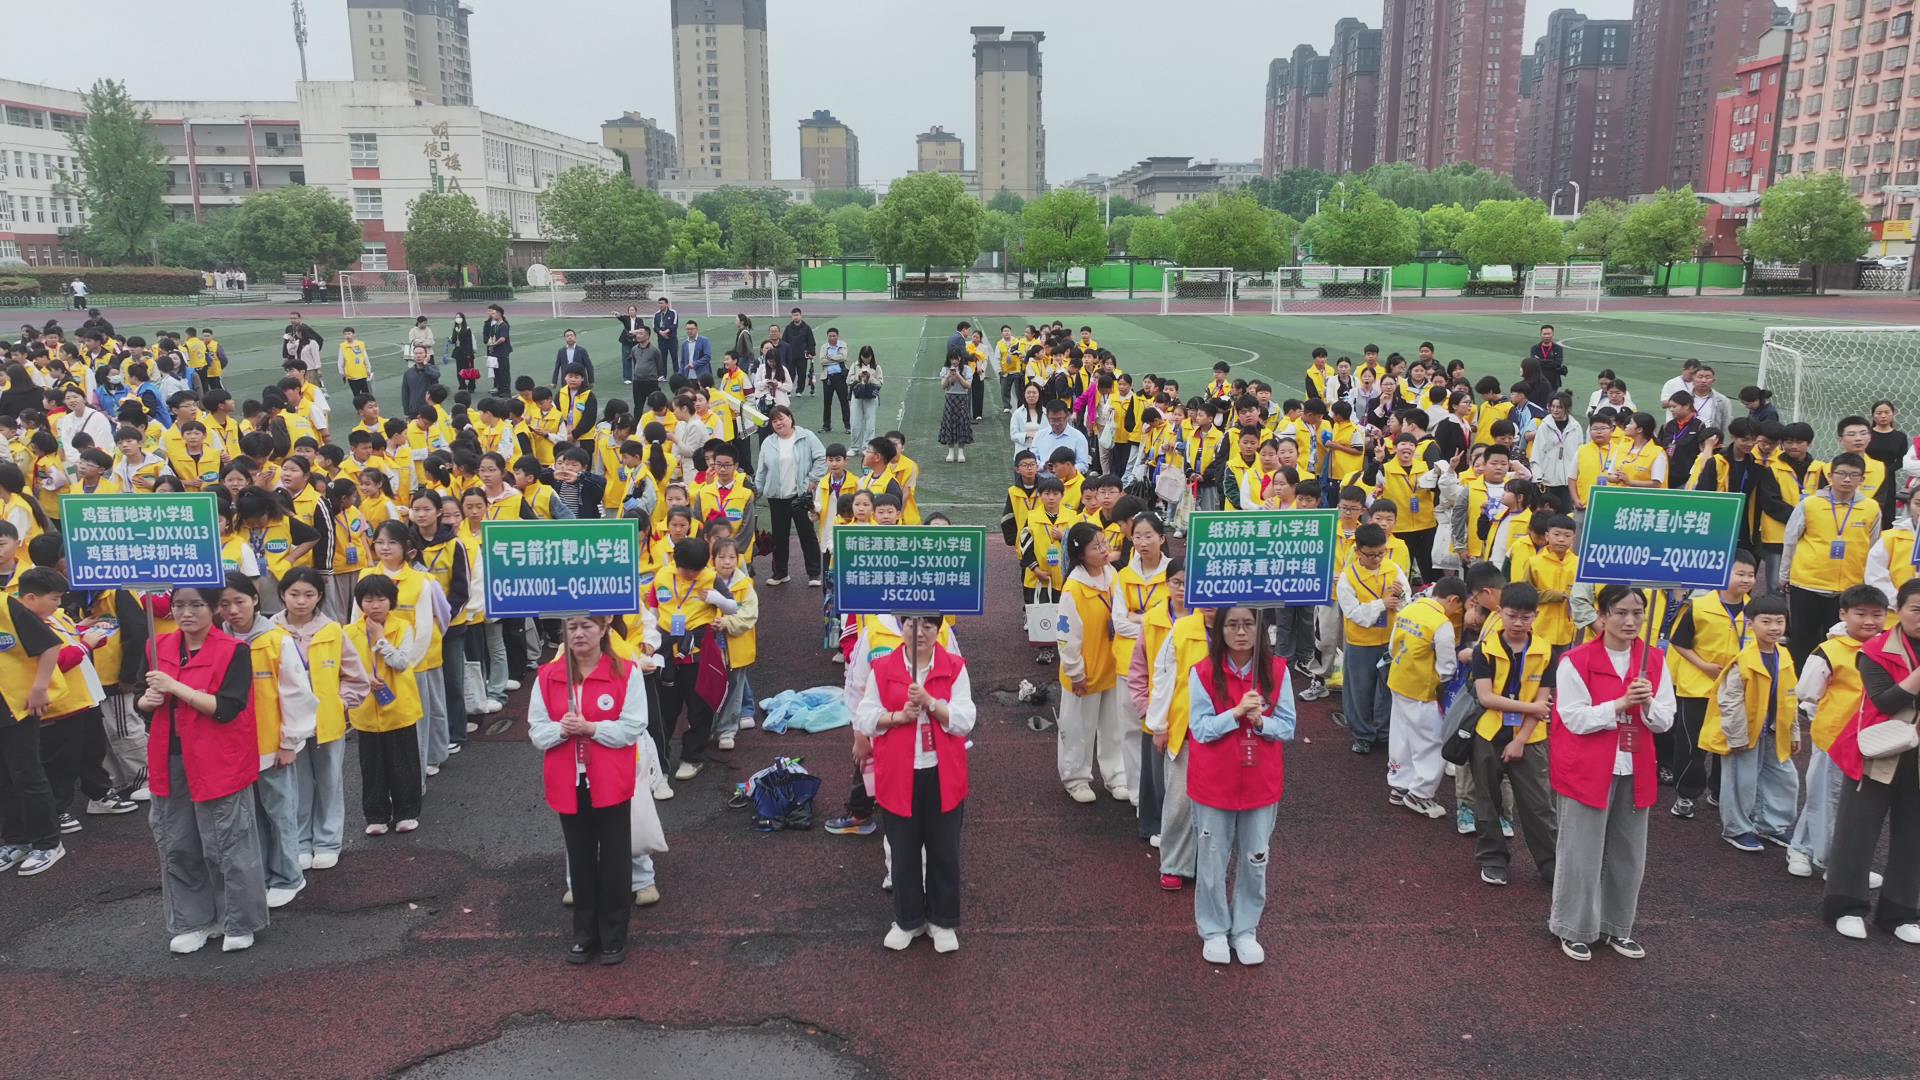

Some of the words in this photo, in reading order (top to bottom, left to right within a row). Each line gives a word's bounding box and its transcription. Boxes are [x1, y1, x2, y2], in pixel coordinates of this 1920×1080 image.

[82, 505, 194, 523] 鸡蛋撞地球小学组
[1613, 506, 1712, 535] 纸桥承重小学组
[1208, 520, 1320, 539] 纸桥承重小学组
[86, 544, 198, 561] 鸡蛋撞地球初中组
[492, 538, 630, 566] 气弓箭打靶小学组
[1205, 558, 1317, 577] 纸桥承重初中组
[880, 589, 936, 601] JSCZ001
